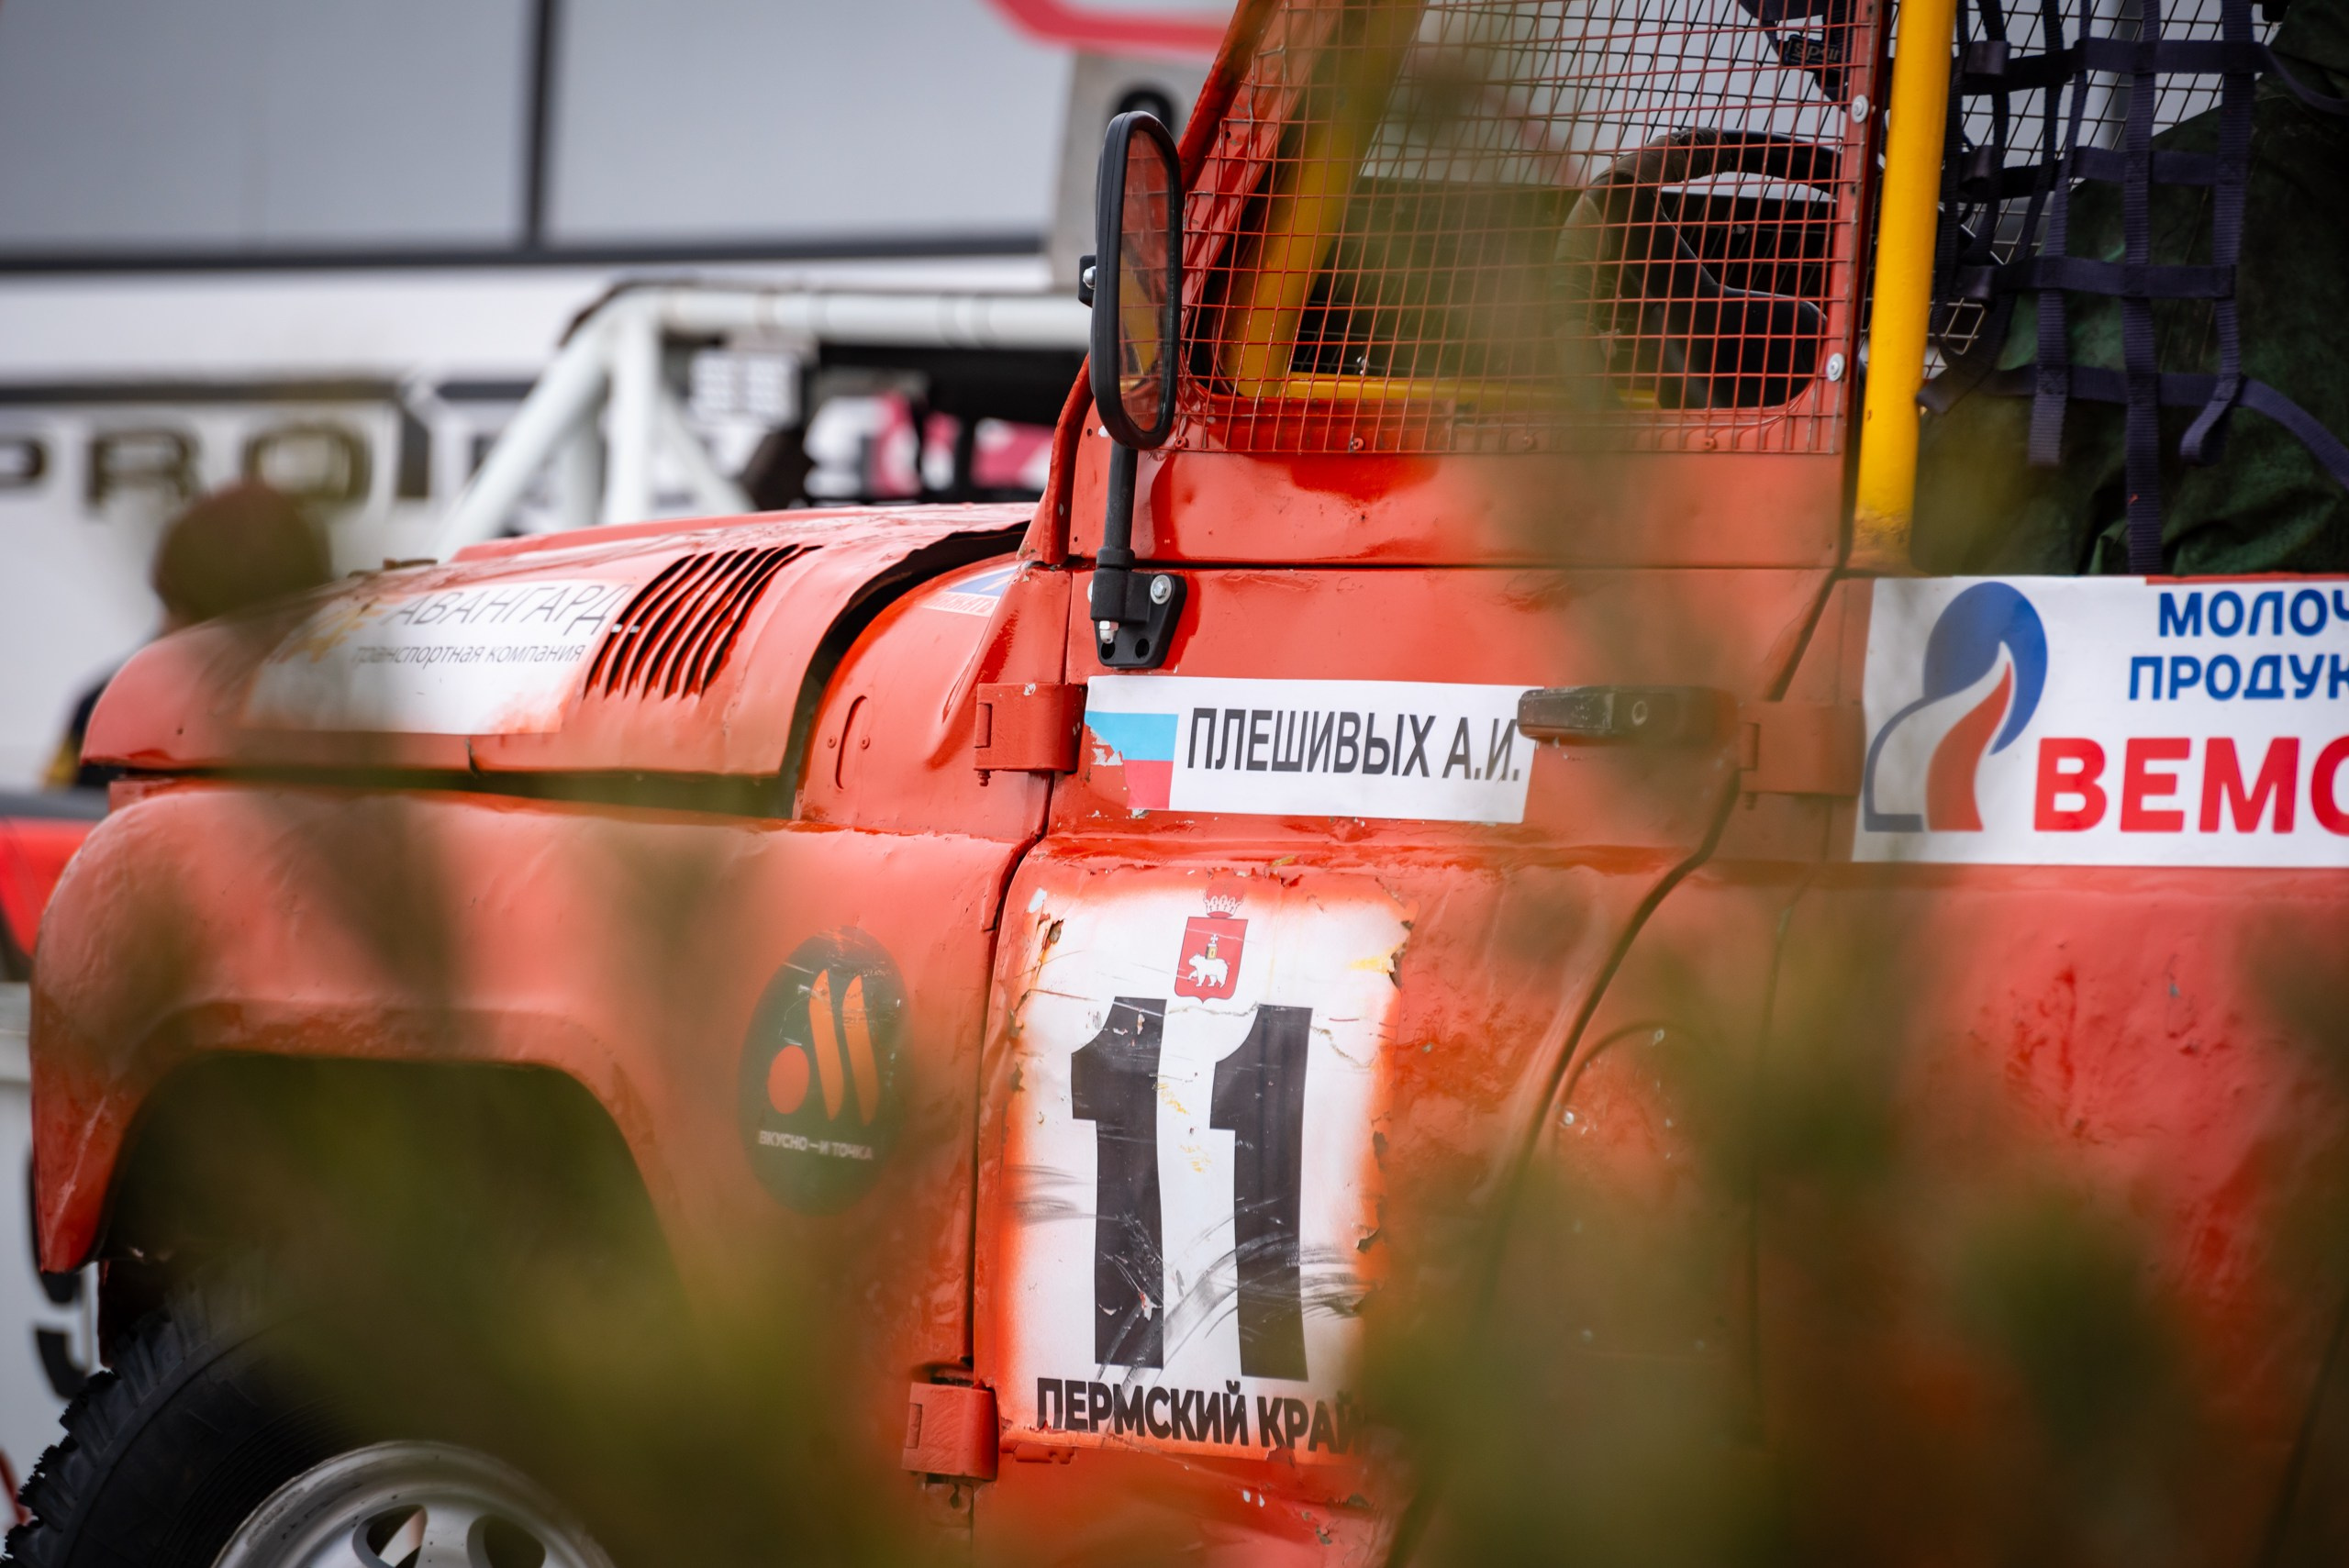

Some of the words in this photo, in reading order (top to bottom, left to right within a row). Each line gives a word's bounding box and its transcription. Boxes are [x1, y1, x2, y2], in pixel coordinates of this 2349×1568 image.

[378, 584, 634, 636] АВАНГАРД
[487, 644, 585, 663] компания
[1187, 706, 1436, 777] ПЛЕШИВЫХ
[1442, 716, 1520, 783] А.И.
[1071, 996, 1312, 1382] 11
[1037, 1377, 1249, 1447] ПЕРМСКИЙ
[1257, 1389, 1368, 1456] КРАЙ
